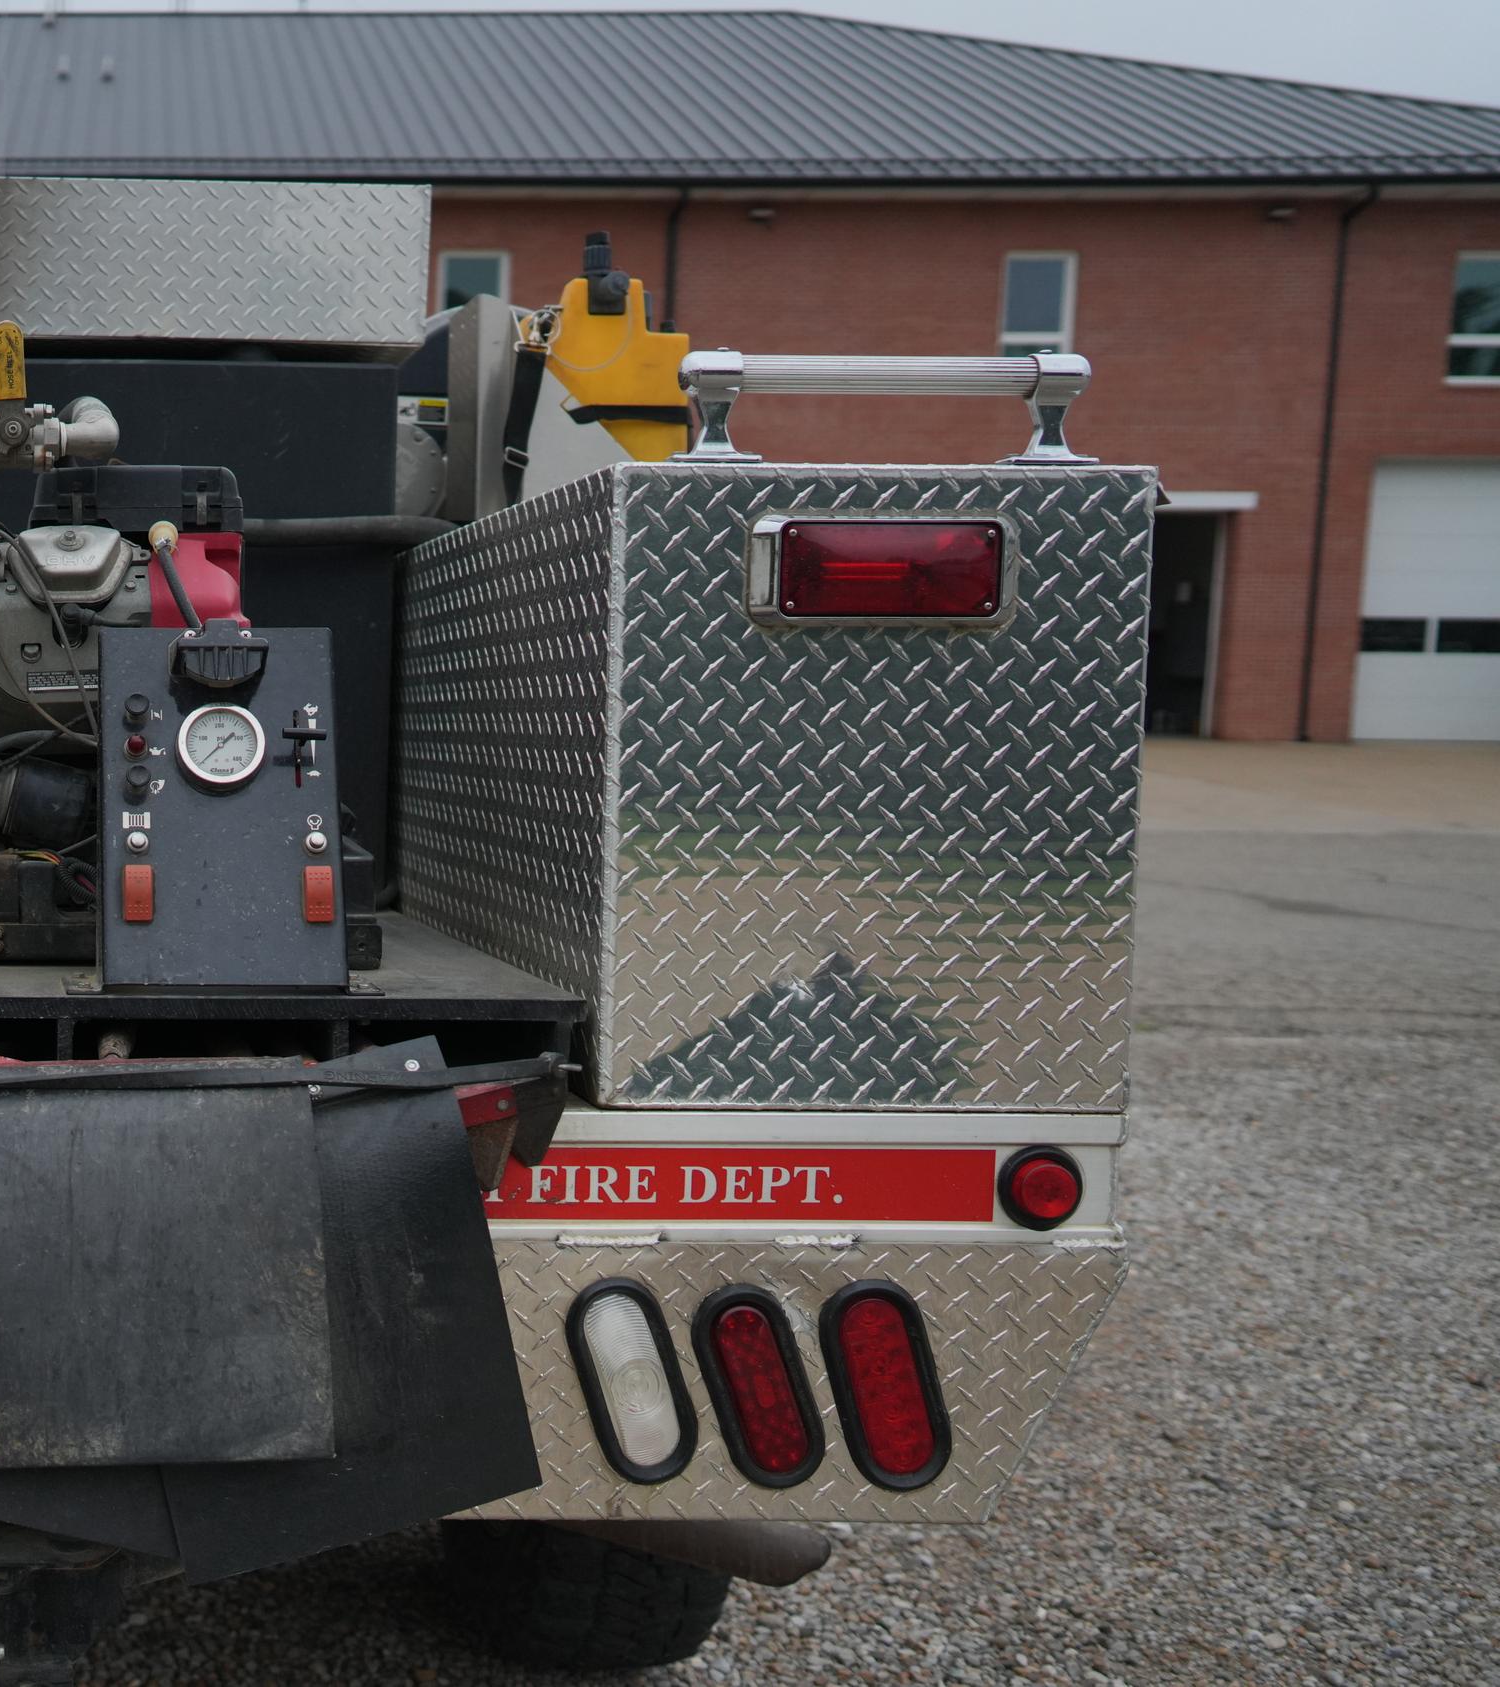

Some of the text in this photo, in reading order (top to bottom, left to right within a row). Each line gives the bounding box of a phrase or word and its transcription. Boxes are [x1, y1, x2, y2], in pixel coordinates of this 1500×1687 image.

[5, 350, 15, 389] HOSE REEL
[526, 1165, 657, 1204] FIRE
[678, 1165, 844, 1204] DEPT.
